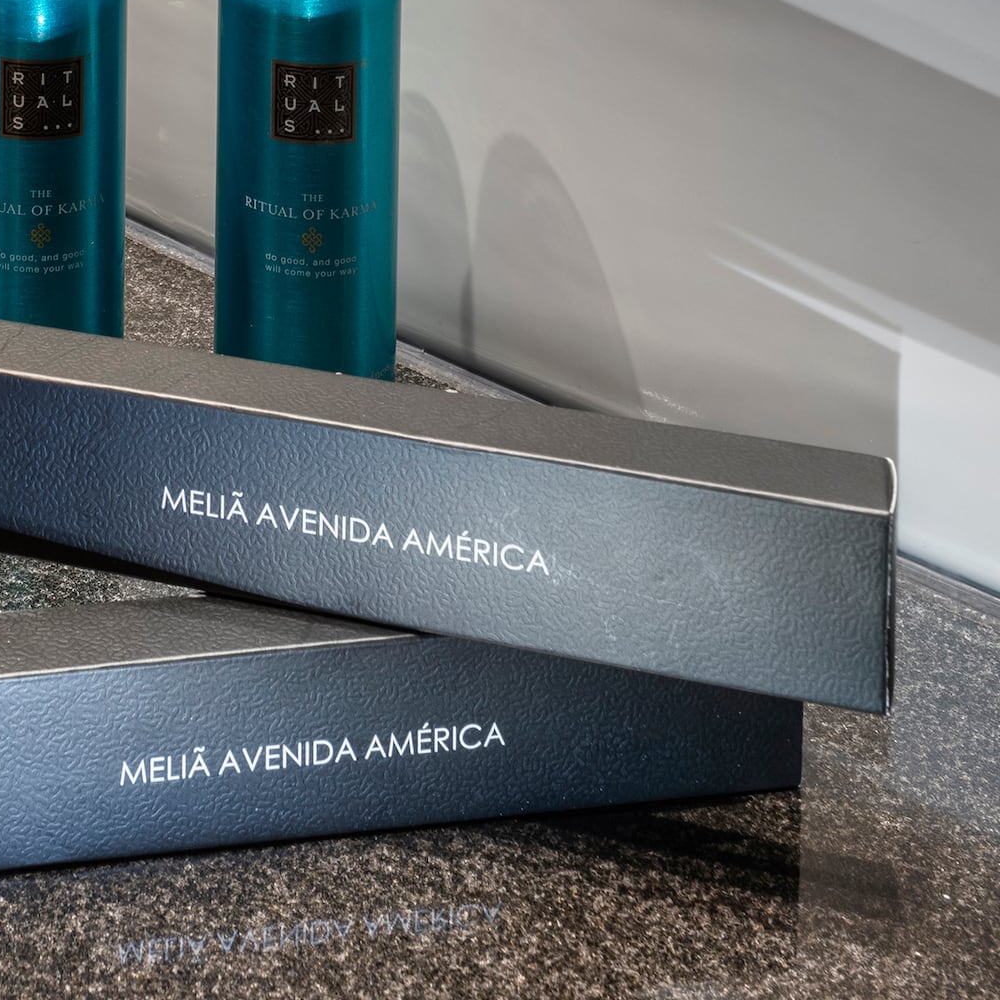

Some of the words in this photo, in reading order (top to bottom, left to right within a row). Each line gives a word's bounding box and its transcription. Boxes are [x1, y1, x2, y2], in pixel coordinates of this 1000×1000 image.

[30, 190, 52, 198] THE
[302, 193, 324, 202] THE
[31, 204, 53, 216] OF
[245, 195, 298, 219] RITUAL
[302, 208, 324, 220] OF
[41, 253, 59, 262] and
[265, 252, 277, 262] do
[312, 257, 331, 266] and
[13, 265, 40, 273] come
[43, 264, 64, 274] your
[265, 264, 281, 273] will
[284, 267, 311, 277] come
[315, 269, 336, 279] your
[256, 502, 394, 549] AVENIDA
[402, 529, 550, 576] AMÉRICA
[218, 737, 357, 776] AVENIDA
[364, 721, 506, 760] AMÉRICA
